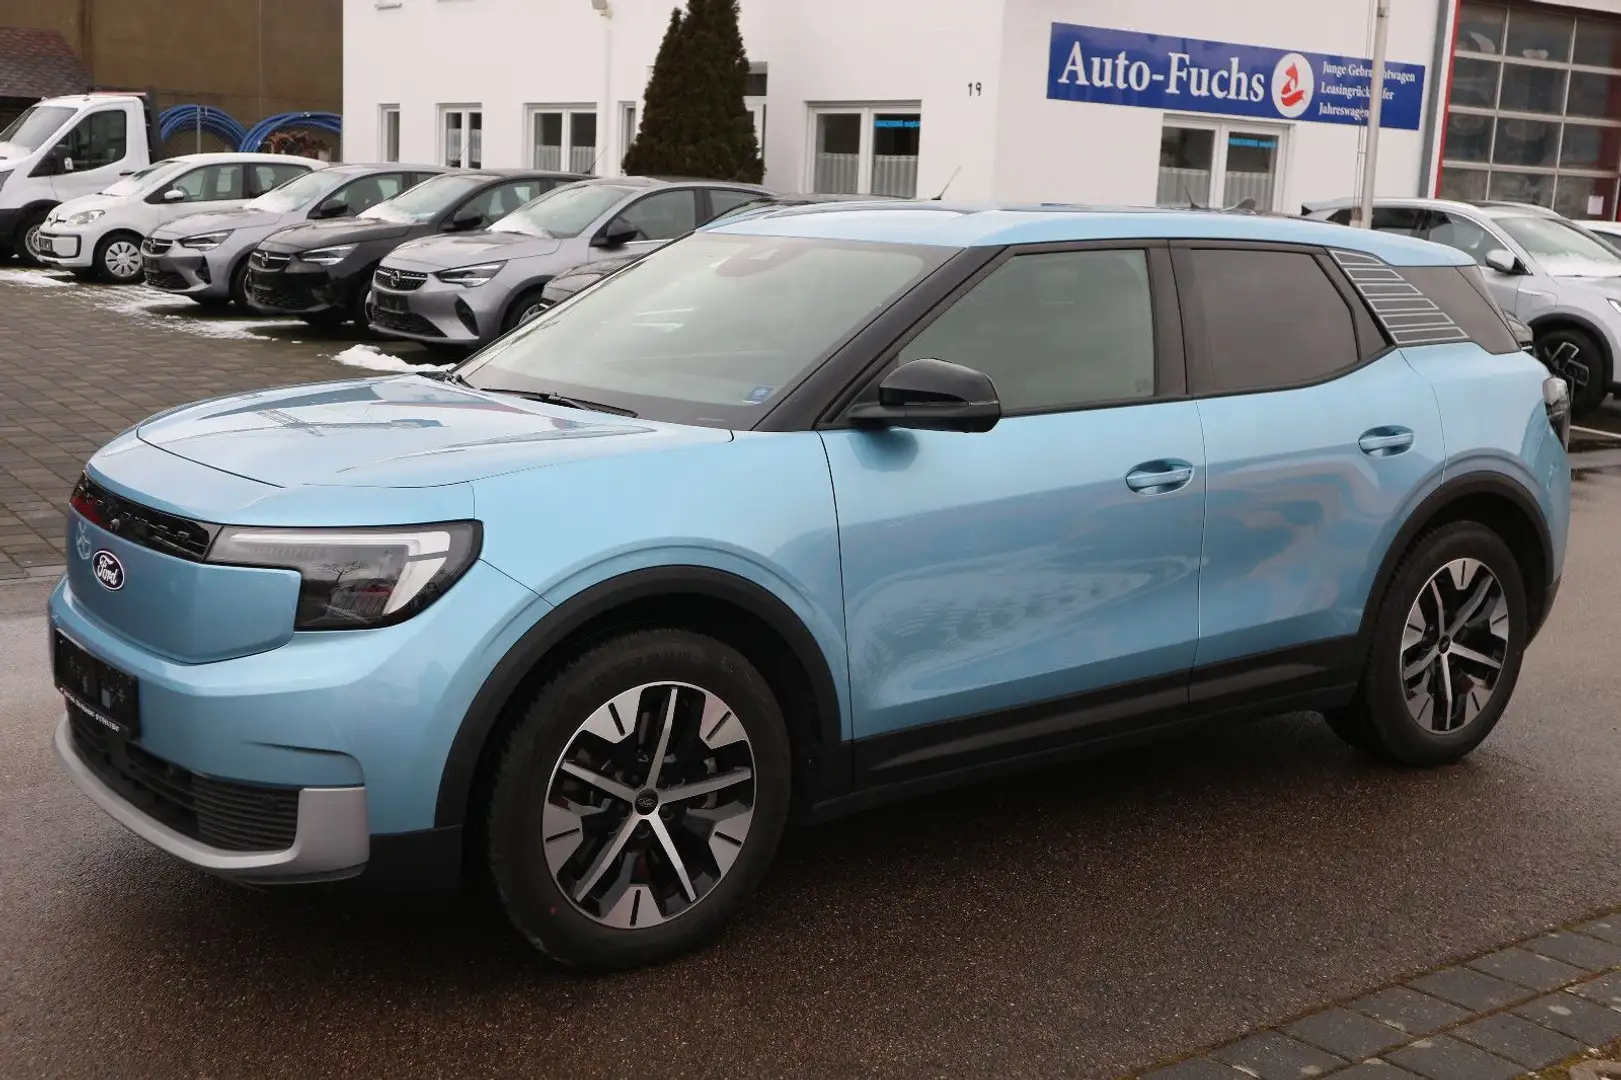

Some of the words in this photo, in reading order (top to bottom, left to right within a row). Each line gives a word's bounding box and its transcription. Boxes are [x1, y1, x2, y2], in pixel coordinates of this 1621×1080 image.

[1058, 40, 1265, 102] Auto-Fuchs
[1322, 61, 1346, 78] Junge
[1348, 63, 1416, 84] Gebrahtwagen
[967, 81, 982, 97] 19
[1320, 81, 1395, 101] Leasingrückfer
[96, 553, 120, 586] Ford
